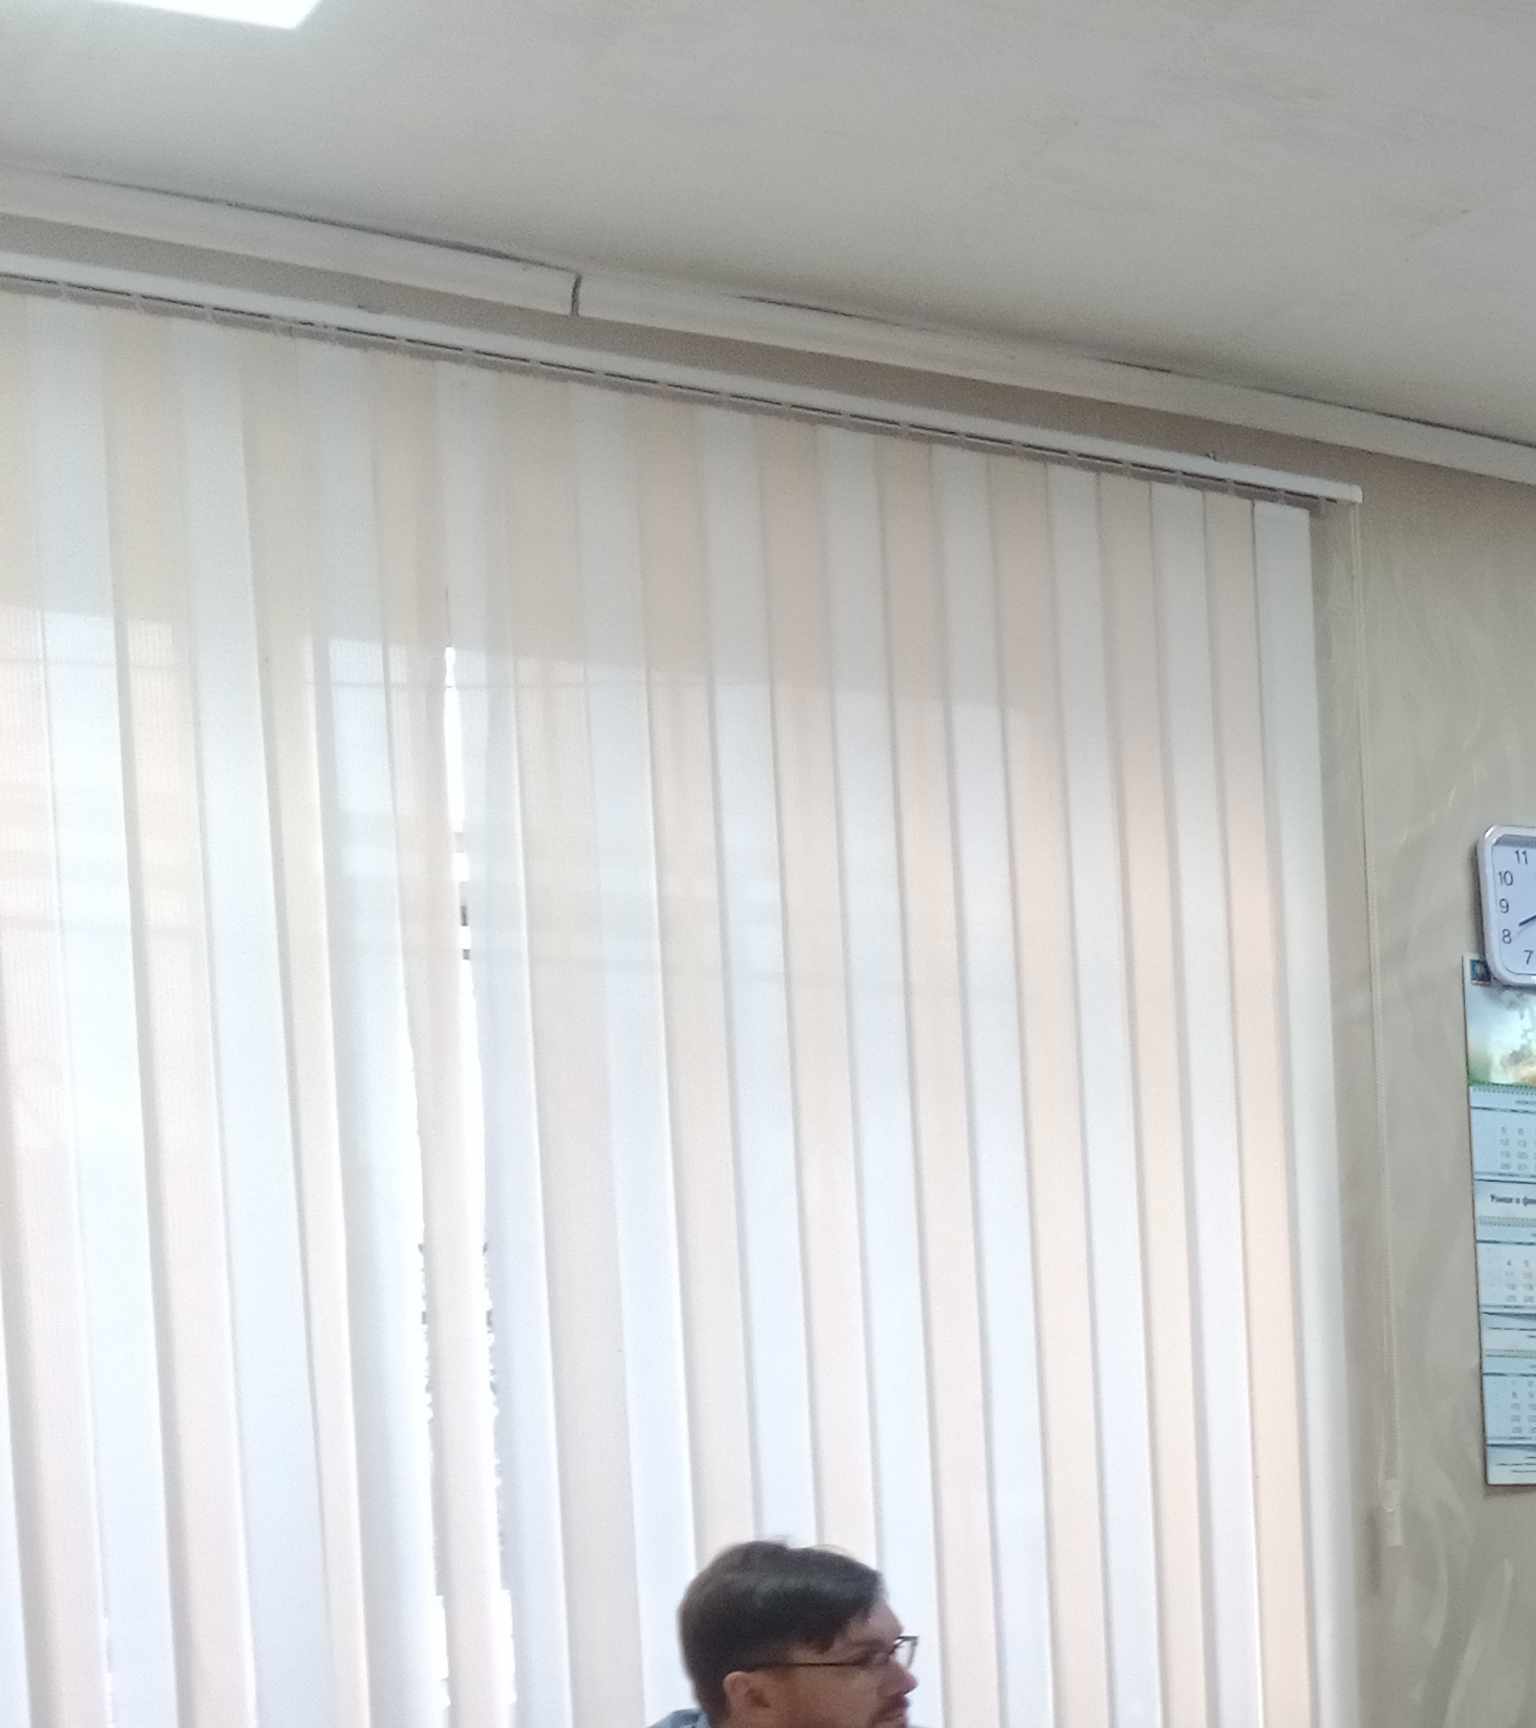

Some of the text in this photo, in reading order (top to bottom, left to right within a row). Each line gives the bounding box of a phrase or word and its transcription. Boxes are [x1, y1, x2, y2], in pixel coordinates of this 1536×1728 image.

[1515, 850, 1528, 864] 11
[1498, 871, 1513, 886] 10
[1499, 899, 1509, 913] 9
[1502, 929, 1512, 944] 8
[1523, 950, 1534, 965] 7
